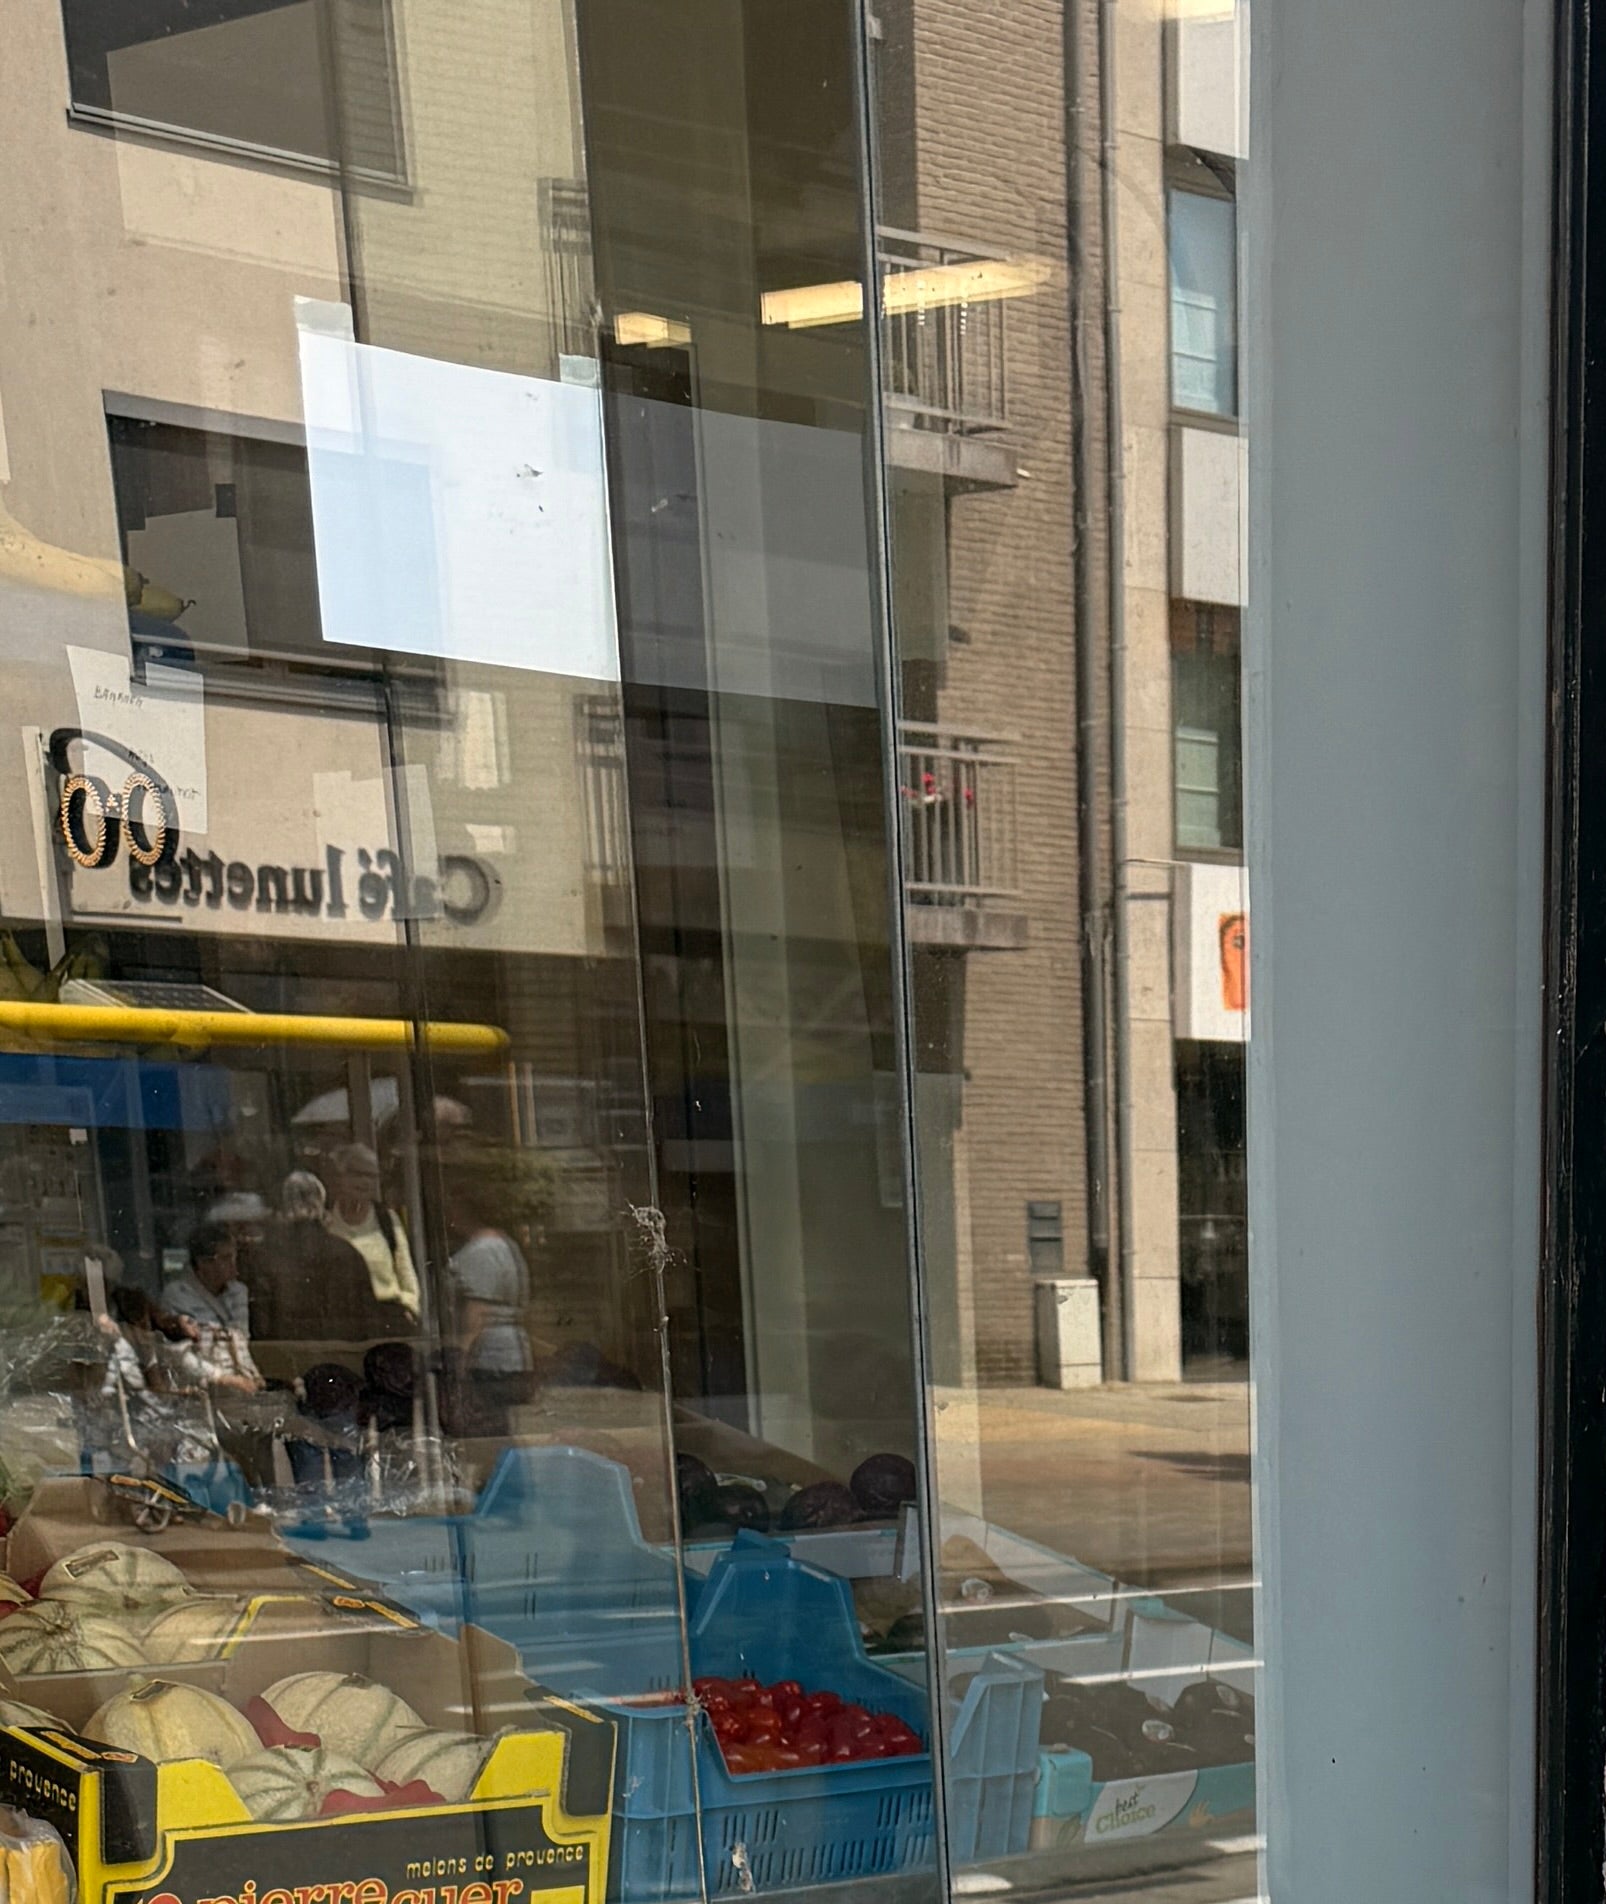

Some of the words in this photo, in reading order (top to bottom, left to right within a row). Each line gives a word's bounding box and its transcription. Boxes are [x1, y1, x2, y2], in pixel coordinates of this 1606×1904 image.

[406, 1856, 467, 1880] melons
[475, 1852, 494, 1872] de
[506, 1845, 584, 1871] provence
